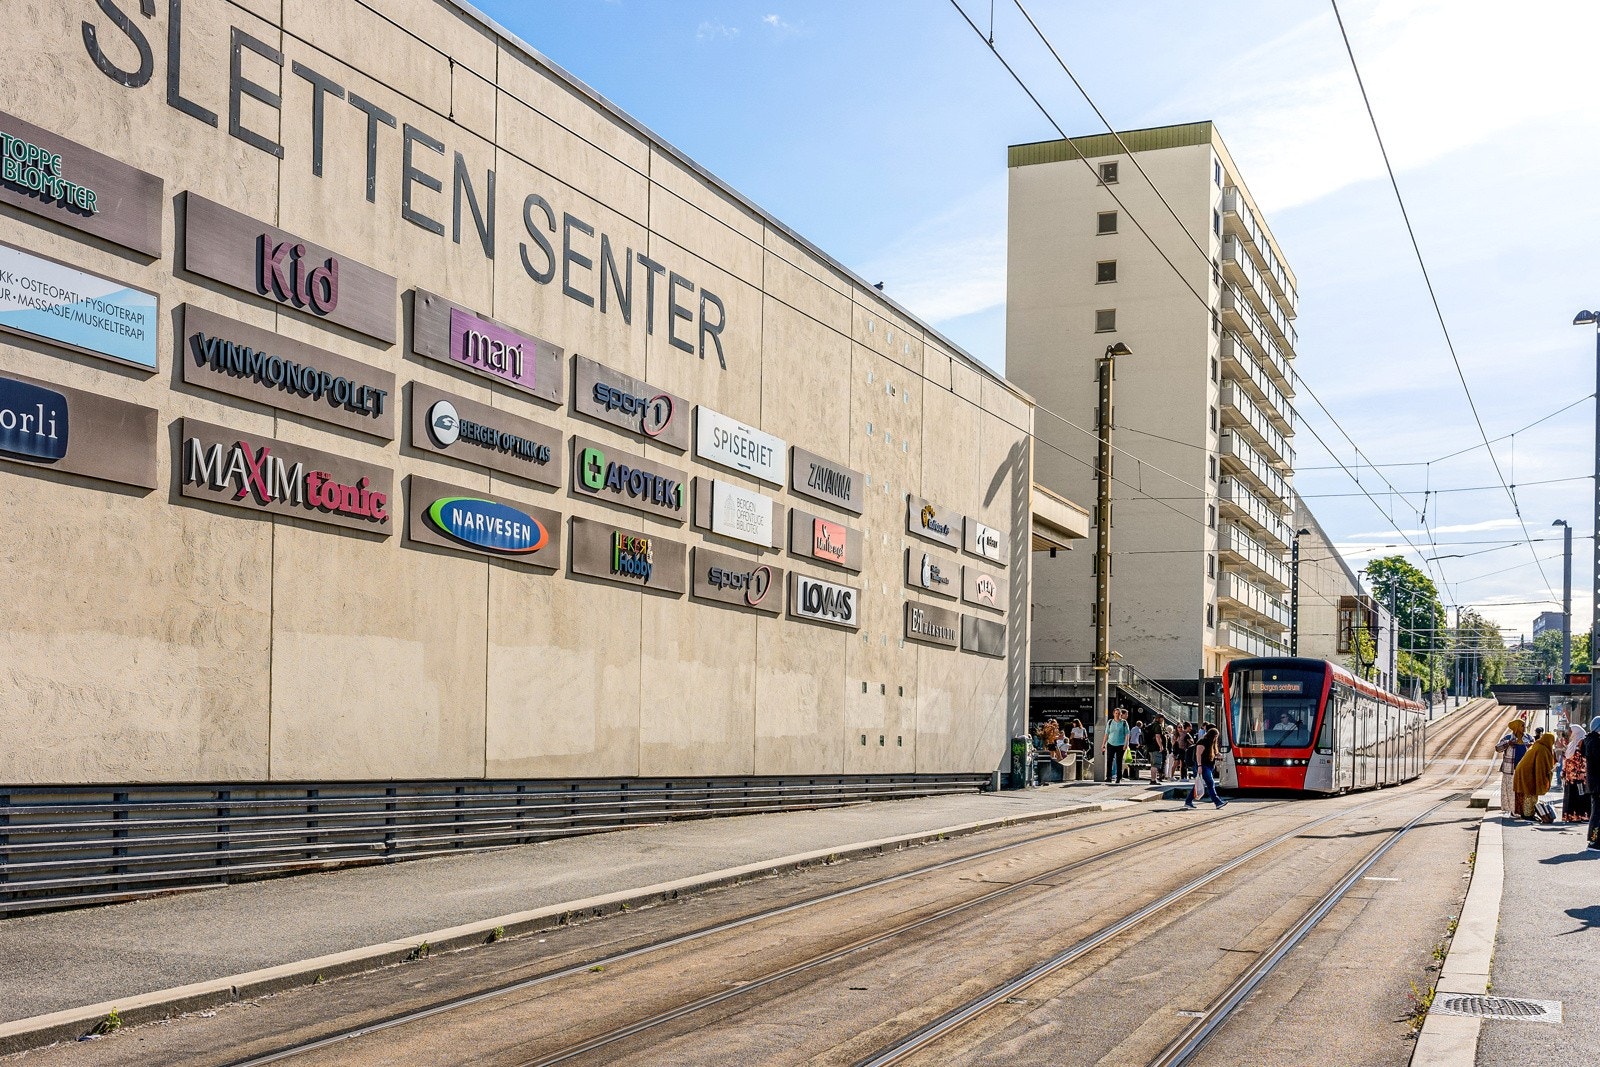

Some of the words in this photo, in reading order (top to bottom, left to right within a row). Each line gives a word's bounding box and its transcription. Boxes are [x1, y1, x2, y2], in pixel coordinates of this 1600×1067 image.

[0, 131, 62, 177] TOPPE
[2, 156, 99, 213] BLOMSTER
[82, 0, 496, 260] SLETTEN
[519, 193, 727, 370] SENTER
[258, 233, 339, 316] Kid
[17, 293, 145, 341] MASSASJE/MUSKELTERAPI
[20, 276, 80, 306] OSTEOPATI
[85, 296, 145, 326] FYSIOTERAPI
[195, 332, 388, 416] VINMONOPOLET
[467, 328, 524, 378] mani
[0, 403, 58, 440] orli
[459, 419, 501, 447] BERGEN
[502, 432, 537, 459] OPTIKK
[539, 444, 551, 463] AS
[188, 437, 304, 504] MAXIM
[713, 426, 773, 468] SPISERIET
[808, 462, 851, 501] ZAVANNA
[452, 507, 532, 541] NARVESEN
[619, 551, 653, 582] Hobby
